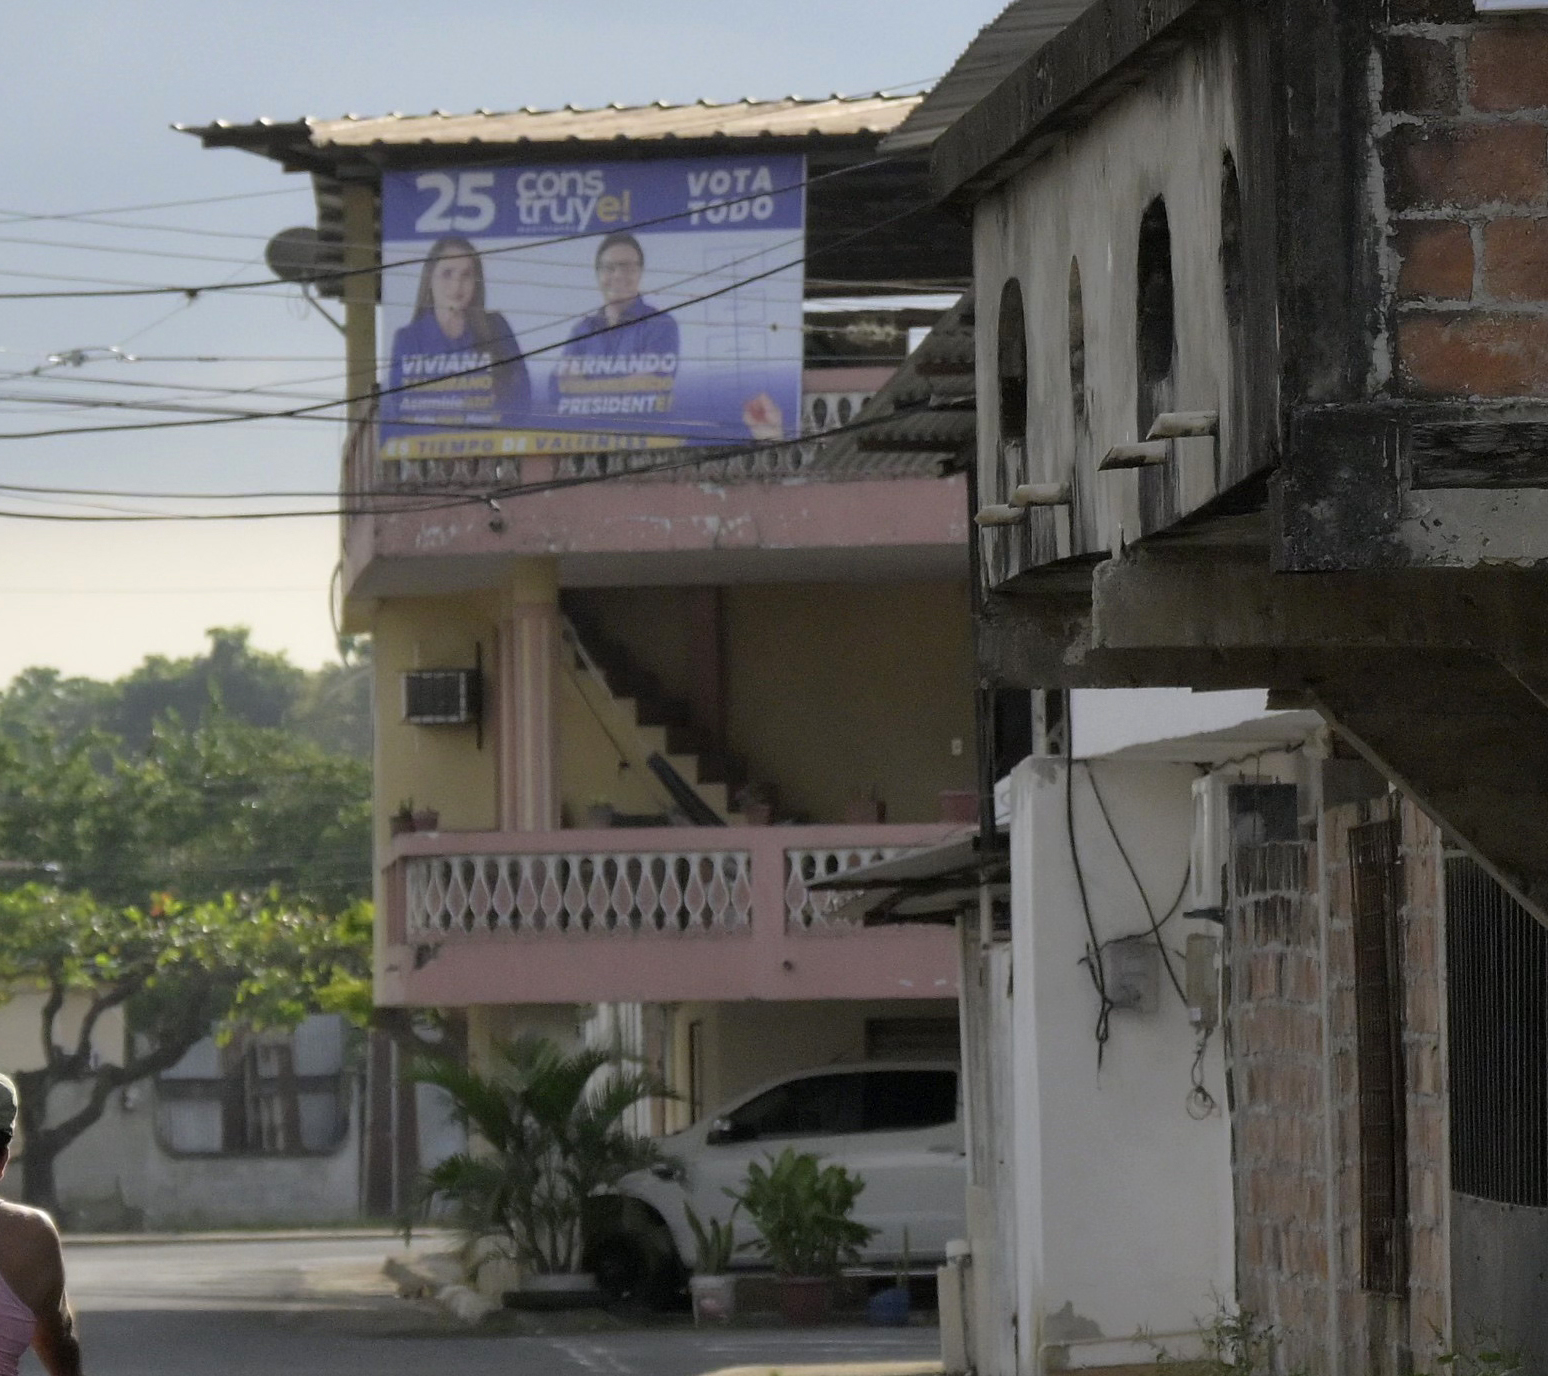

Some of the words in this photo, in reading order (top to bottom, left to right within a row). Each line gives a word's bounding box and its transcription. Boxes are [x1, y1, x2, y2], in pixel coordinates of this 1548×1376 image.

[515, 169, 606, 199] cons
[686, 165, 773, 197] VOTA
[414, 172, 496, 234] 25
[686, 198, 774, 226] TODO
[401, 352, 493, 376] VIVIANA
[557, 353, 677, 376] FERNANDO
[384, 440, 410, 456] ES
[418, 438, 495, 454] TIEMPO
[501, 436, 528, 453] DE
[535, 435, 648, 452] VALIENTES
